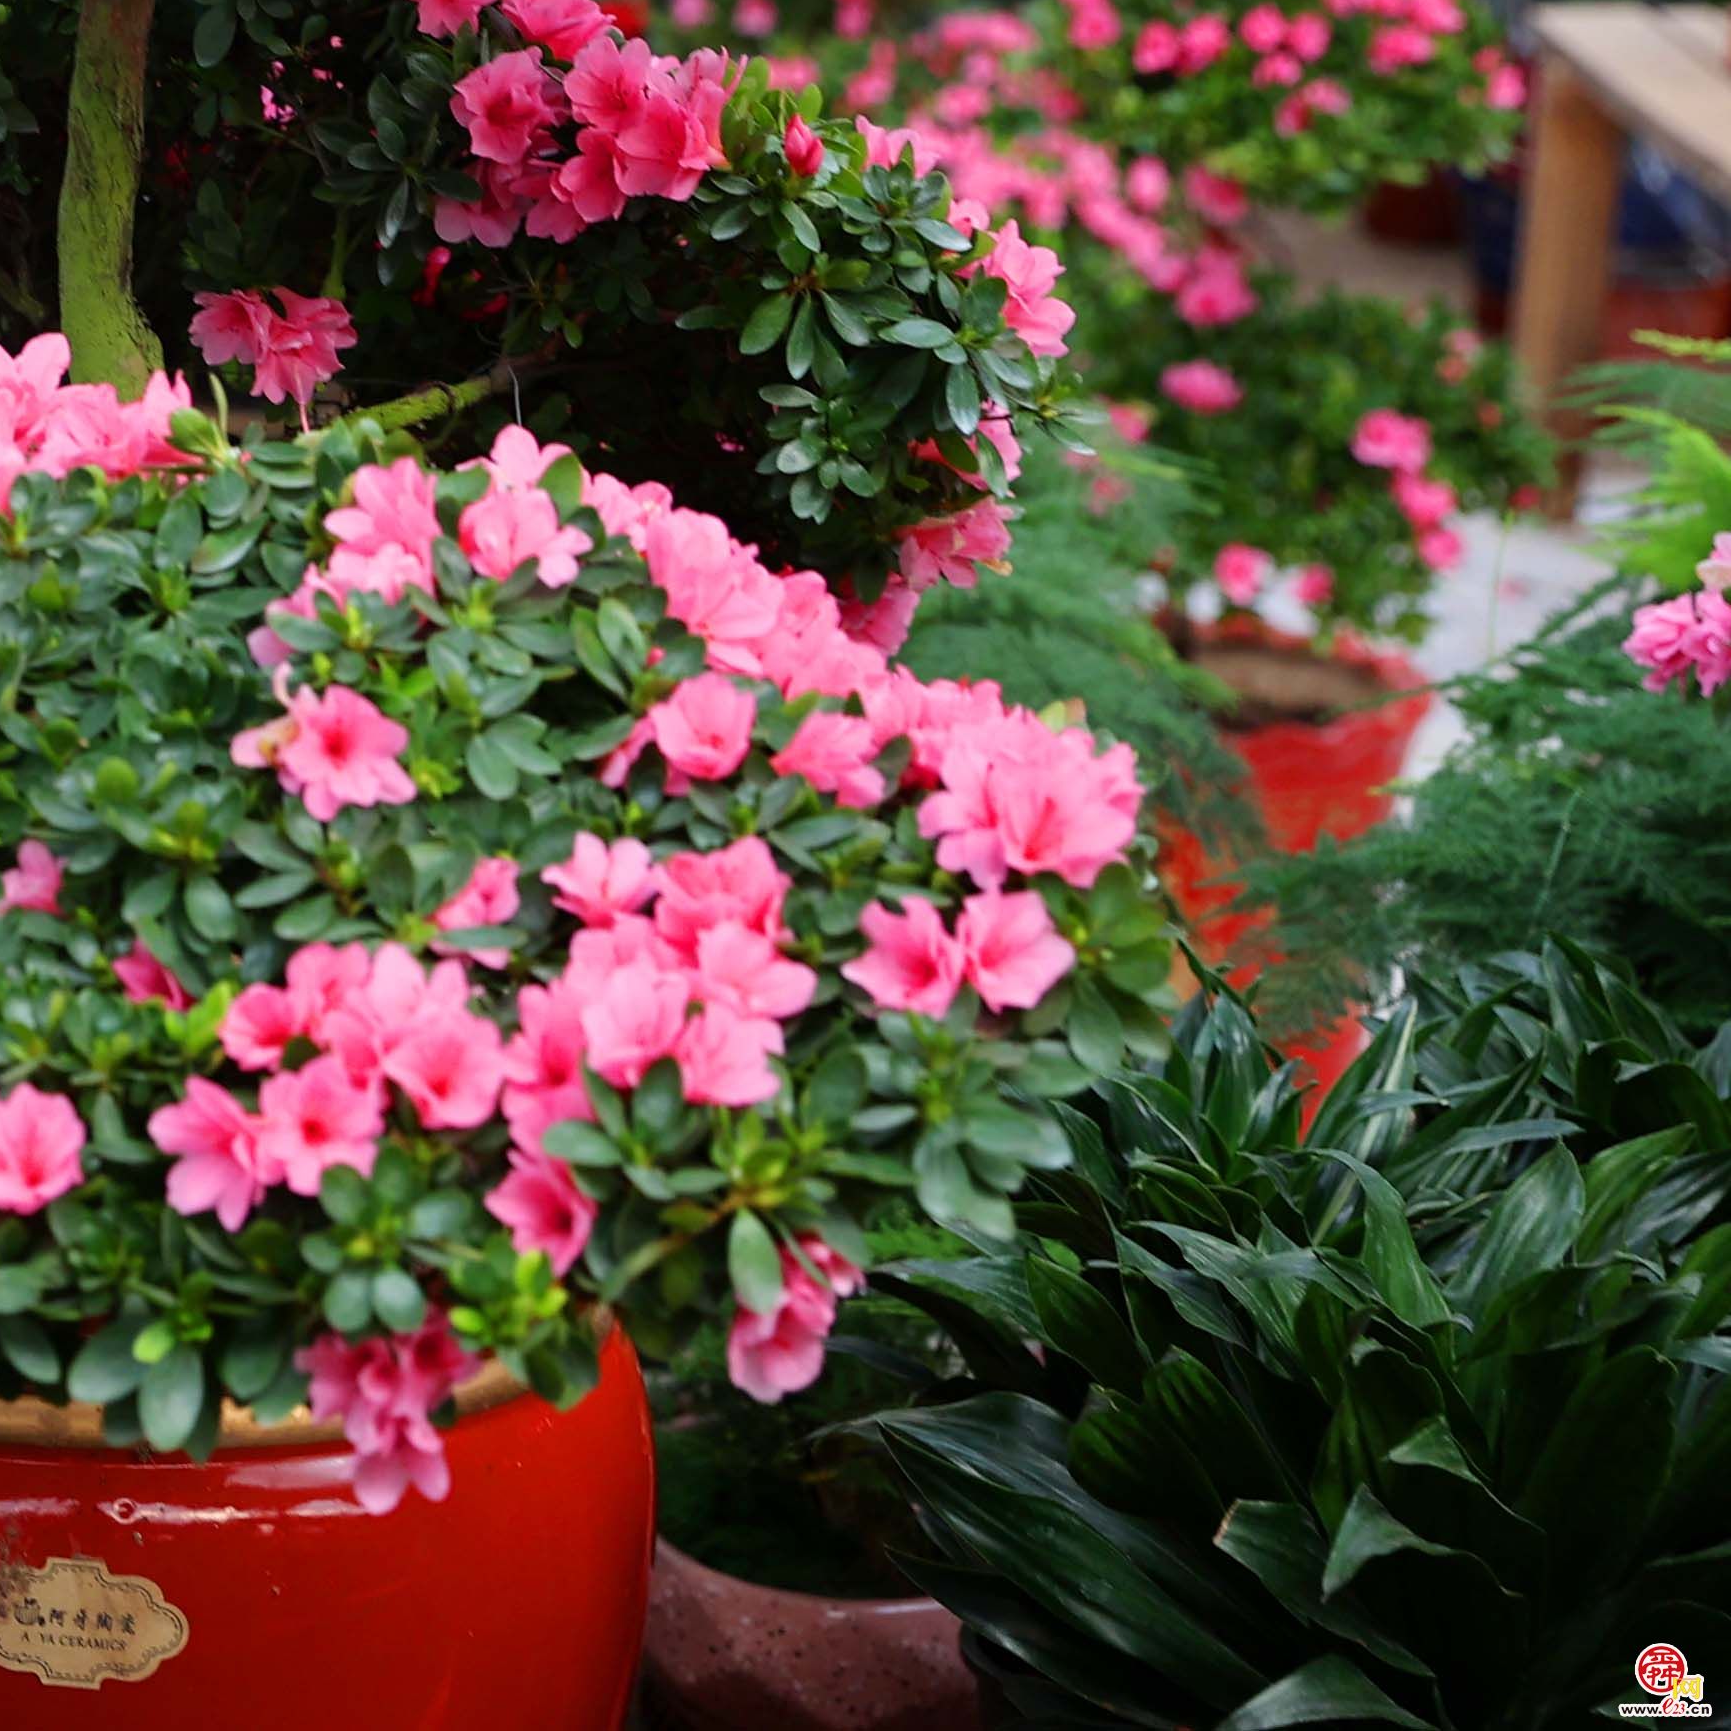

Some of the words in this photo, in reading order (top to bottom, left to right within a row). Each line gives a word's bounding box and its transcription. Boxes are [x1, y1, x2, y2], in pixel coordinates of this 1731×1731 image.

[21, 1632, 31, 1643] A
[39, 1632, 55, 1646] YA
[59, 1635, 128, 1652] CERAMICS
